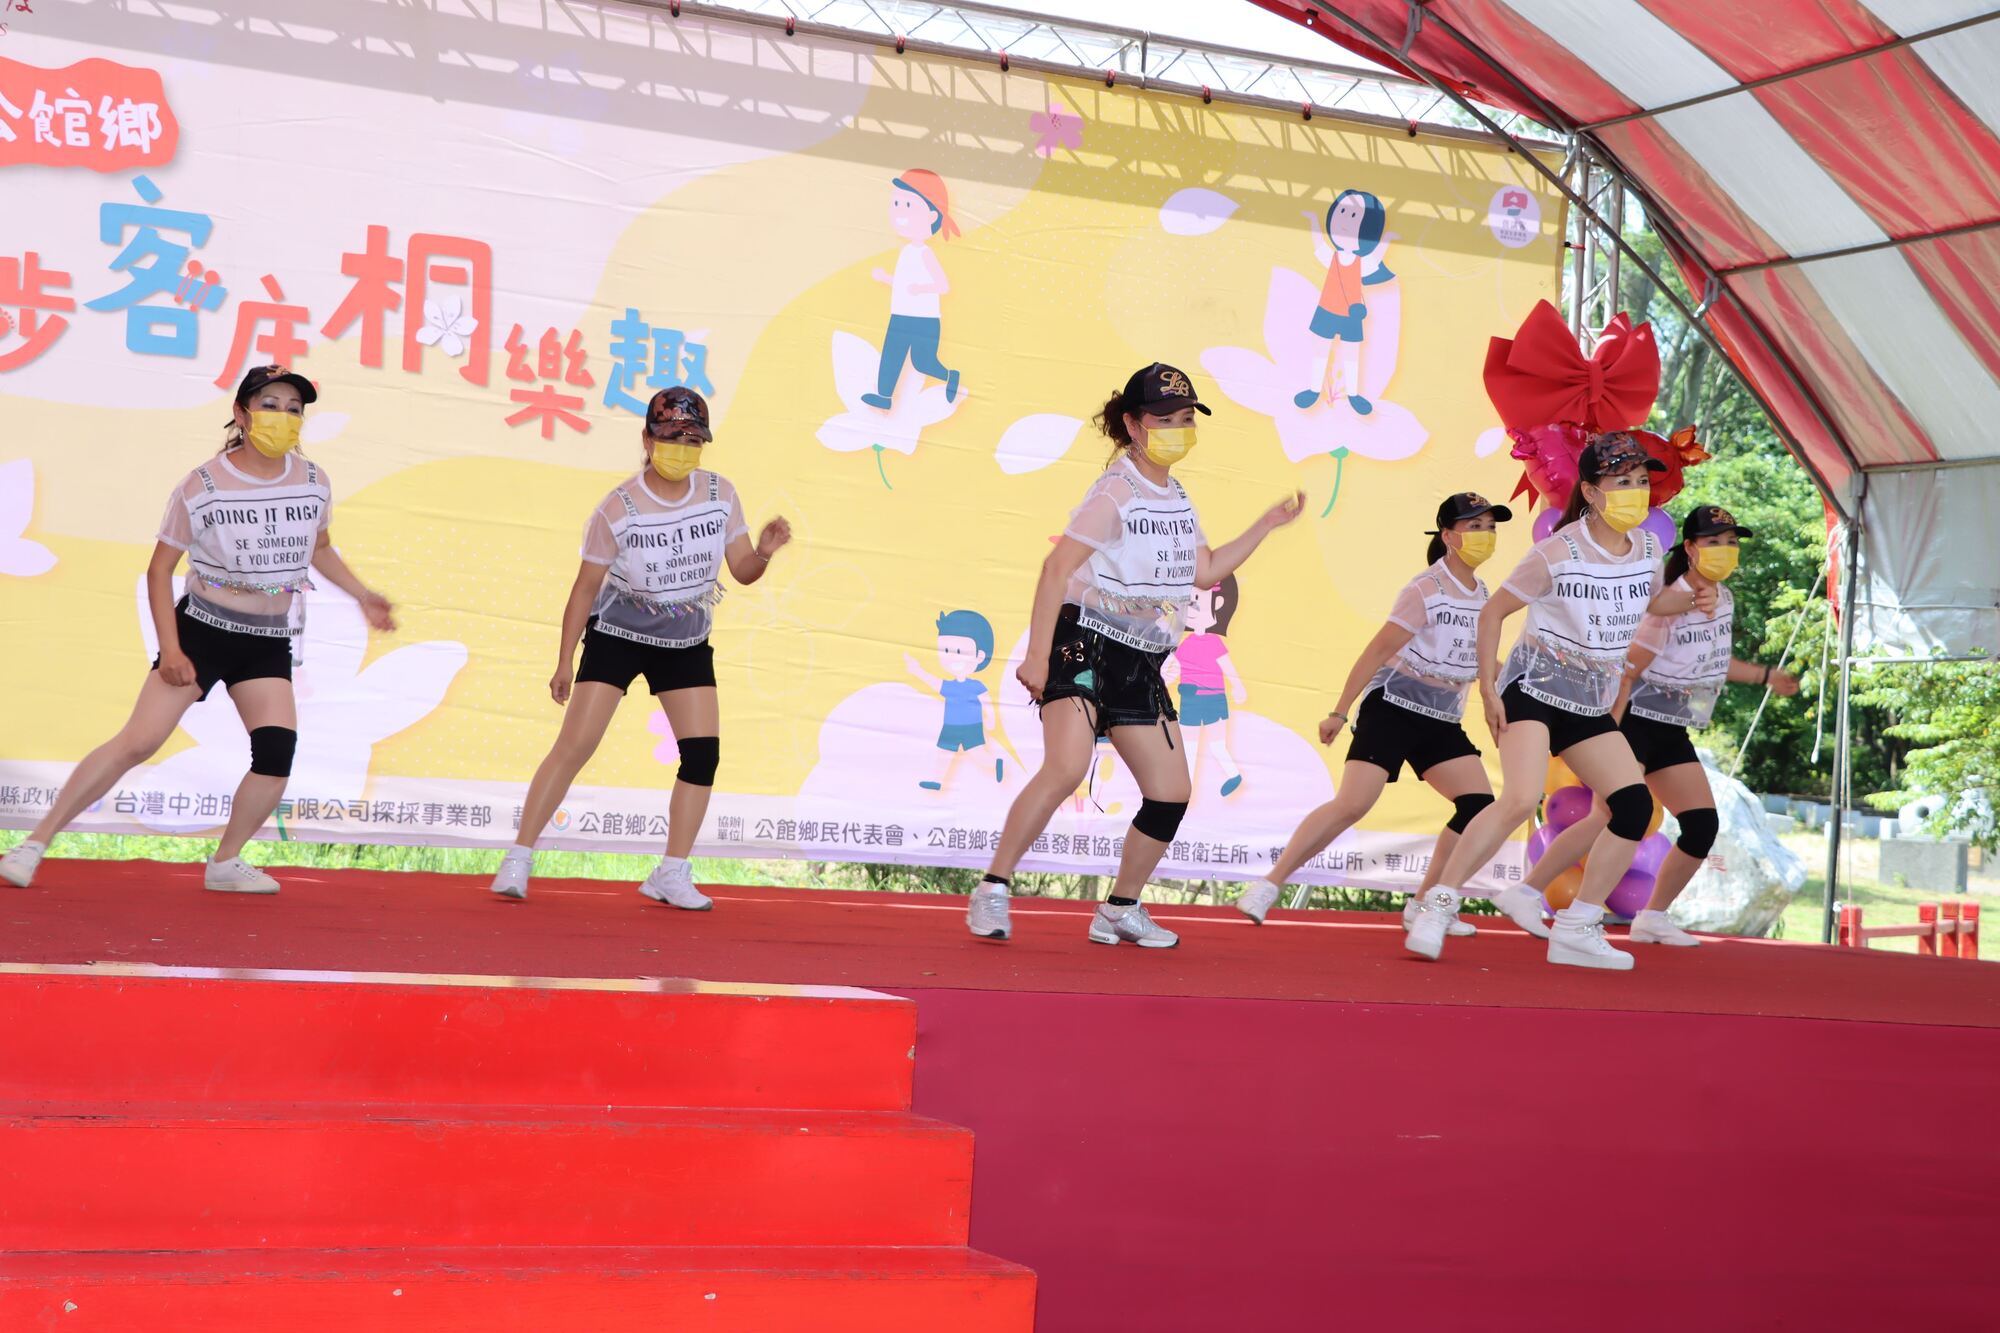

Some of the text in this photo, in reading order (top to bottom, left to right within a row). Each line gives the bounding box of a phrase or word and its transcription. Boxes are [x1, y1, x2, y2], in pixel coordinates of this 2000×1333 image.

[265, 508, 278, 523] IT
[236, 536, 309, 550] SE SOMEONE
[249, 553, 270, 565] YOU
[646, 551, 713, 573] SE SOMEONE
[658, 573, 676, 585] YOU
[1589, 614, 1601, 625] SE
[114, 790, 492, 828] 台灣中油有限公司探採事業部
[579, 812, 669, 837] 公館鄉公
[1492, 863, 1521, 881] 廣告
